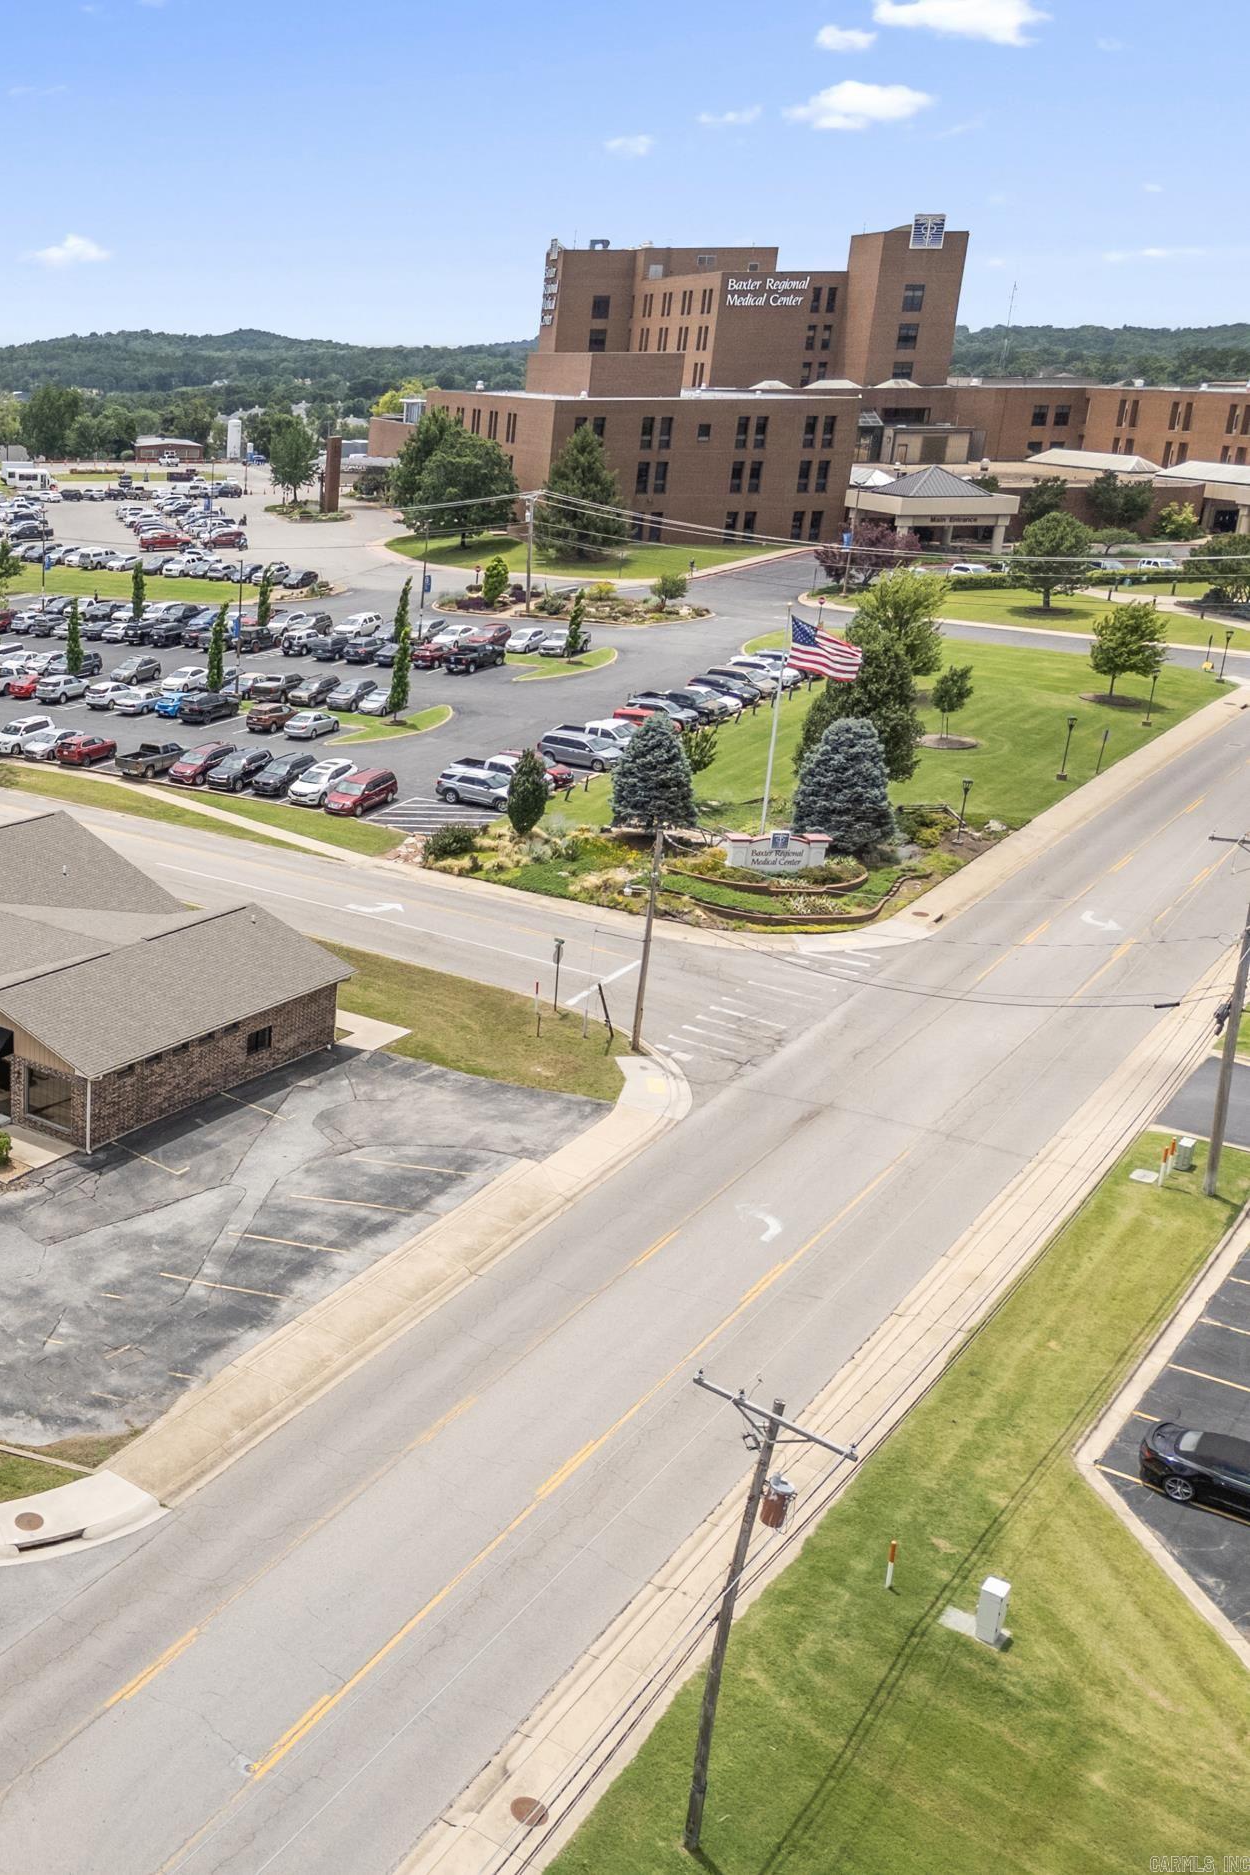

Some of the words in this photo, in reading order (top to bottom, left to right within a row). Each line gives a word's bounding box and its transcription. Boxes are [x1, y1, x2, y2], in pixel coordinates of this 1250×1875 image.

[727, 278, 762, 290] Baxter
[765, 276, 810, 293] Regional
[726, 293, 767, 306] Medical
[769, 294, 804, 306] Center
[949, 515, 978, 523] Entrance
[775, 849, 804, 859] Regional
[751, 858, 777, 866] Medical
[779, 858, 801, 866] Center
